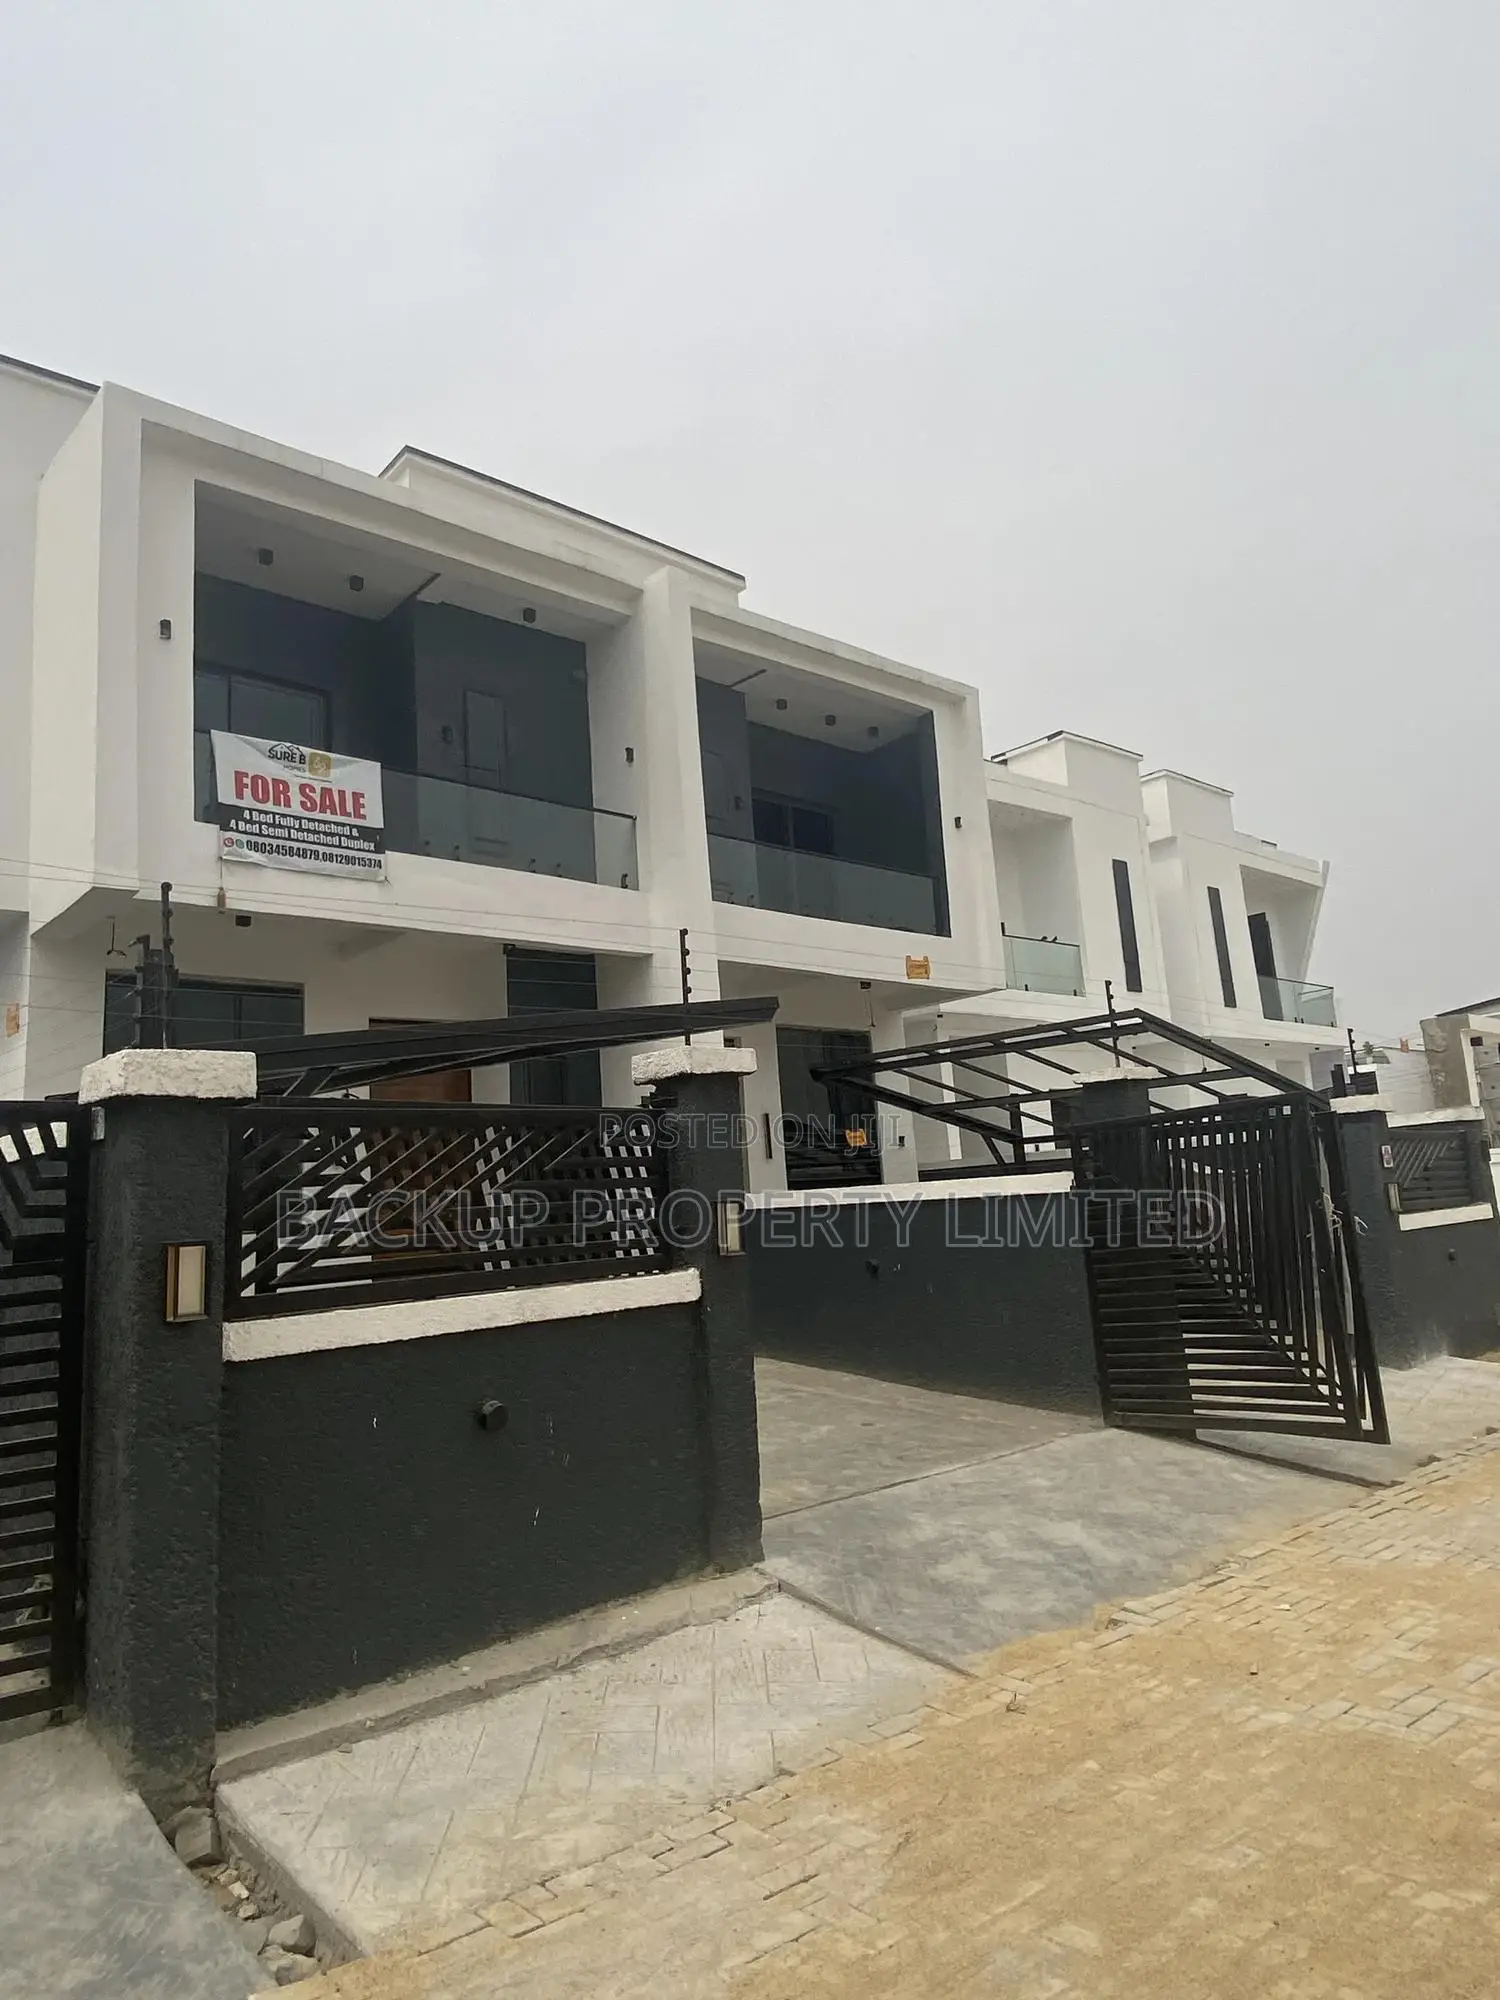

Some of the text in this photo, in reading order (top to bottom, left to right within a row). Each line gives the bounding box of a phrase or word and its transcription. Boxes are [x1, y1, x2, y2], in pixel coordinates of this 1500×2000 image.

[268, 749, 306, 764] SURE B
[234, 770, 367, 820] FOR SALE
[229, 819, 375, 851] 4 Bed Semi Detached Duplex
[243, 810, 250, 819] 4
[252, 811, 273, 823] Bed
[275, 815, 300, 828] Fully
[301, 819, 350, 835] Detached
